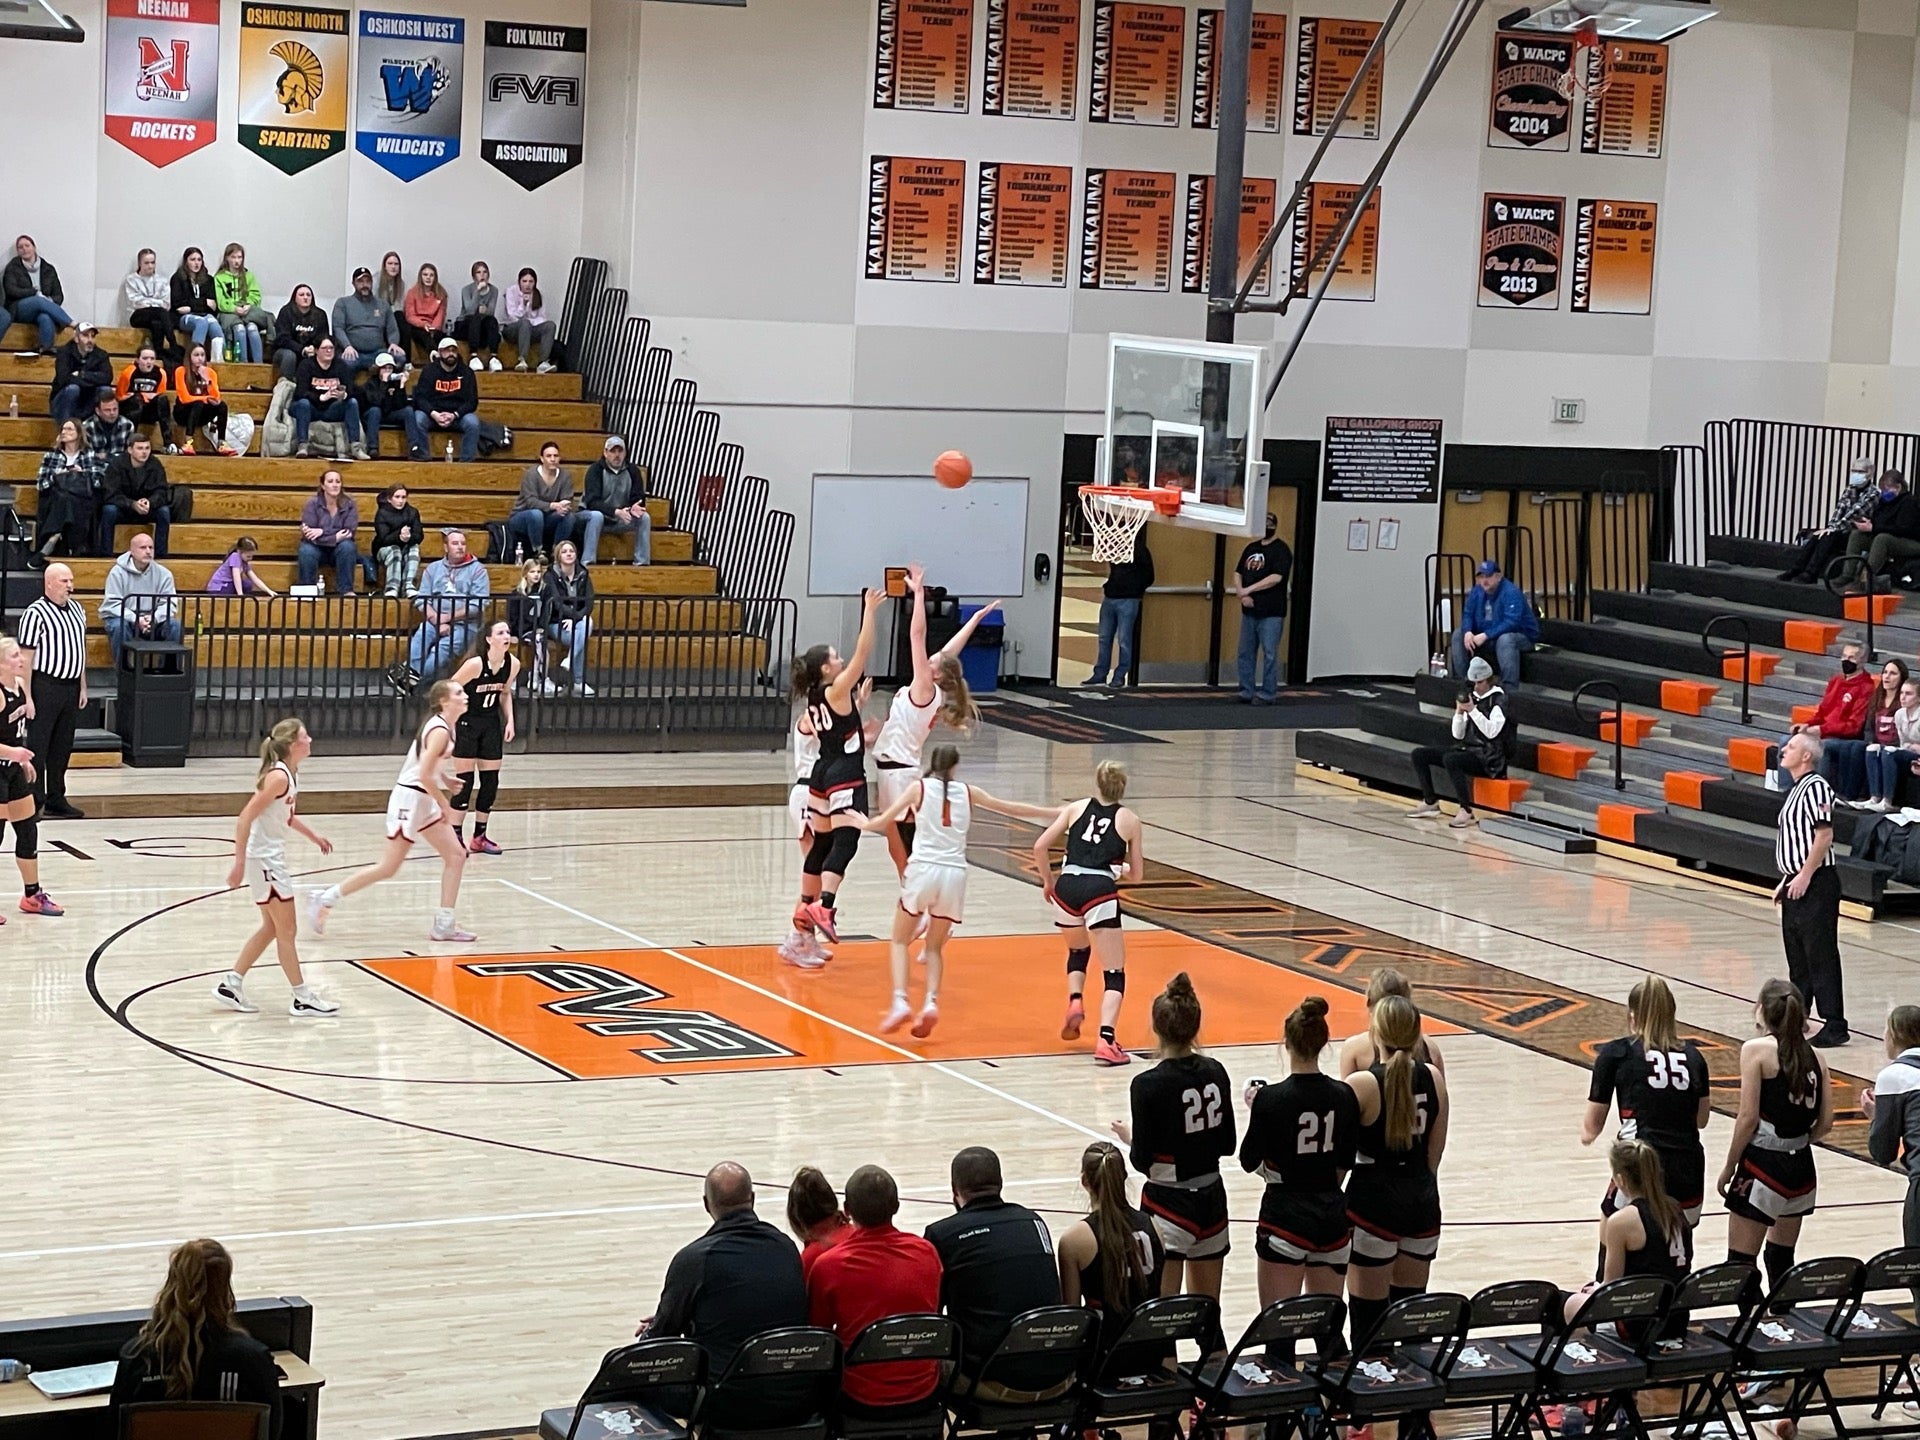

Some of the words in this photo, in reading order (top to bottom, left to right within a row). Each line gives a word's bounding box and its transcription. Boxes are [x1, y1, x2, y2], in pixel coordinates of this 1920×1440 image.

[137, 0, 189, 18] NEENAH
[246, 7, 301, 28] OSHKOSH
[304, 12, 344, 31] NORTH
[367, 17, 422, 37] OSHKOSH
[423, 21, 456, 39] WEST
[506, 28, 527, 45] FOX
[528, 29, 566, 48] VALLEY
[876, 0, 897, 104] KAUKAUN
[984, 0, 1005, 110] KAUKAUNA
[1092, 6, 1112, 117] KAUKAUNA
[1523, 47, 1566, 62] WACPC
[1194, 14, 1214, 123] KAUKAUNA
[1295, 21, 1316, 130] KAUKAUNA
[1498, 66, 1527, 90] STATE
[145, 87, 181, 100] NEENAH
[489, 73, 580, 106] FVA
[130, 121, 197, 141] ROCKETS
[1509, 116, 1550, 135] 2004
[258, 129, 331, 150] SPARTANS
[376, 137, 445, 157] WILDCATS
[495, 144, 568, 163] ASSOCIATION
[915, 166, 945, 175] STATE
[913, 187, 945, 196] TEAMS
[868, 160, 889, 274] KAUKAUNA
[976, 166, 998, 279] KAUKAUNA
[1512, 206, 1555, 221] WACPC
[1617, 208, 1648, 219] STATE
[1082, 172, 1104, 284] KAUKAUNA
[1184, 178, 1205, 288] KAUKAUNA
[1291, 186, 1312, 293] AUKAUNA
[1486, 225, 1517, 251] STATE
[1518, 225, 1559, 254] CHAMPS
[1574, 204, 1594, 308] KAUKAUNA
[1500, 275, 1537, 293] 2013
[1560, 403, 1578, 419] EXIT
[1328, 418, 1348, 428] THE
[1349, 419, 1406, 430] GALLOPING
[1407, 420, 1441, 431] GHOST
[809, 704, 833, 732] 20
[1081, 814, 1112, 845] 13
[1645, 1050, 1691, 1091] 35
[1182, 1082, 1223, 1135] 22
[1297, 1110, 1336, 1155] 21
